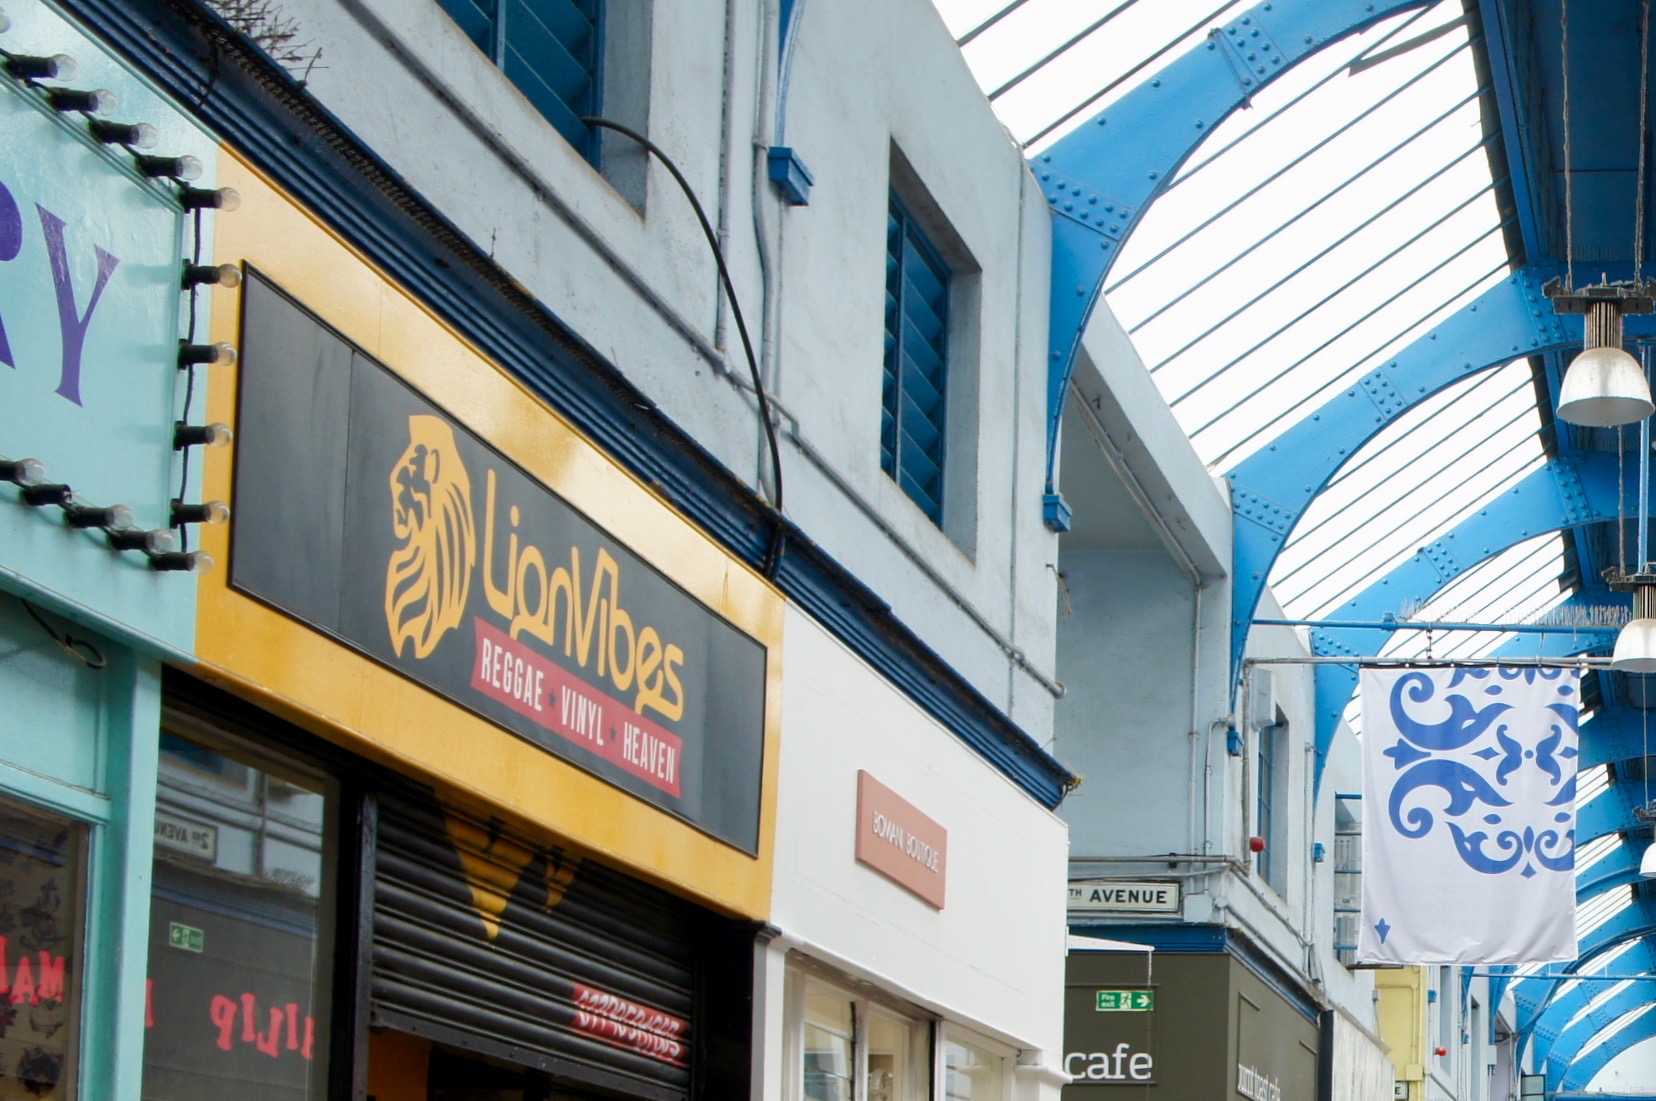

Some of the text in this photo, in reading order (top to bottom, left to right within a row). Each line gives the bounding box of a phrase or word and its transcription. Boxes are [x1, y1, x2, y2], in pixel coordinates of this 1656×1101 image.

[483, 468, 684, 722] LionVibes
[480, 637, 677, 785] REGGAE VINYL HEAVEN
[1089, 889, 1167, 904] AVENUE
[1064, 1043, 1152, 1080] cafe
